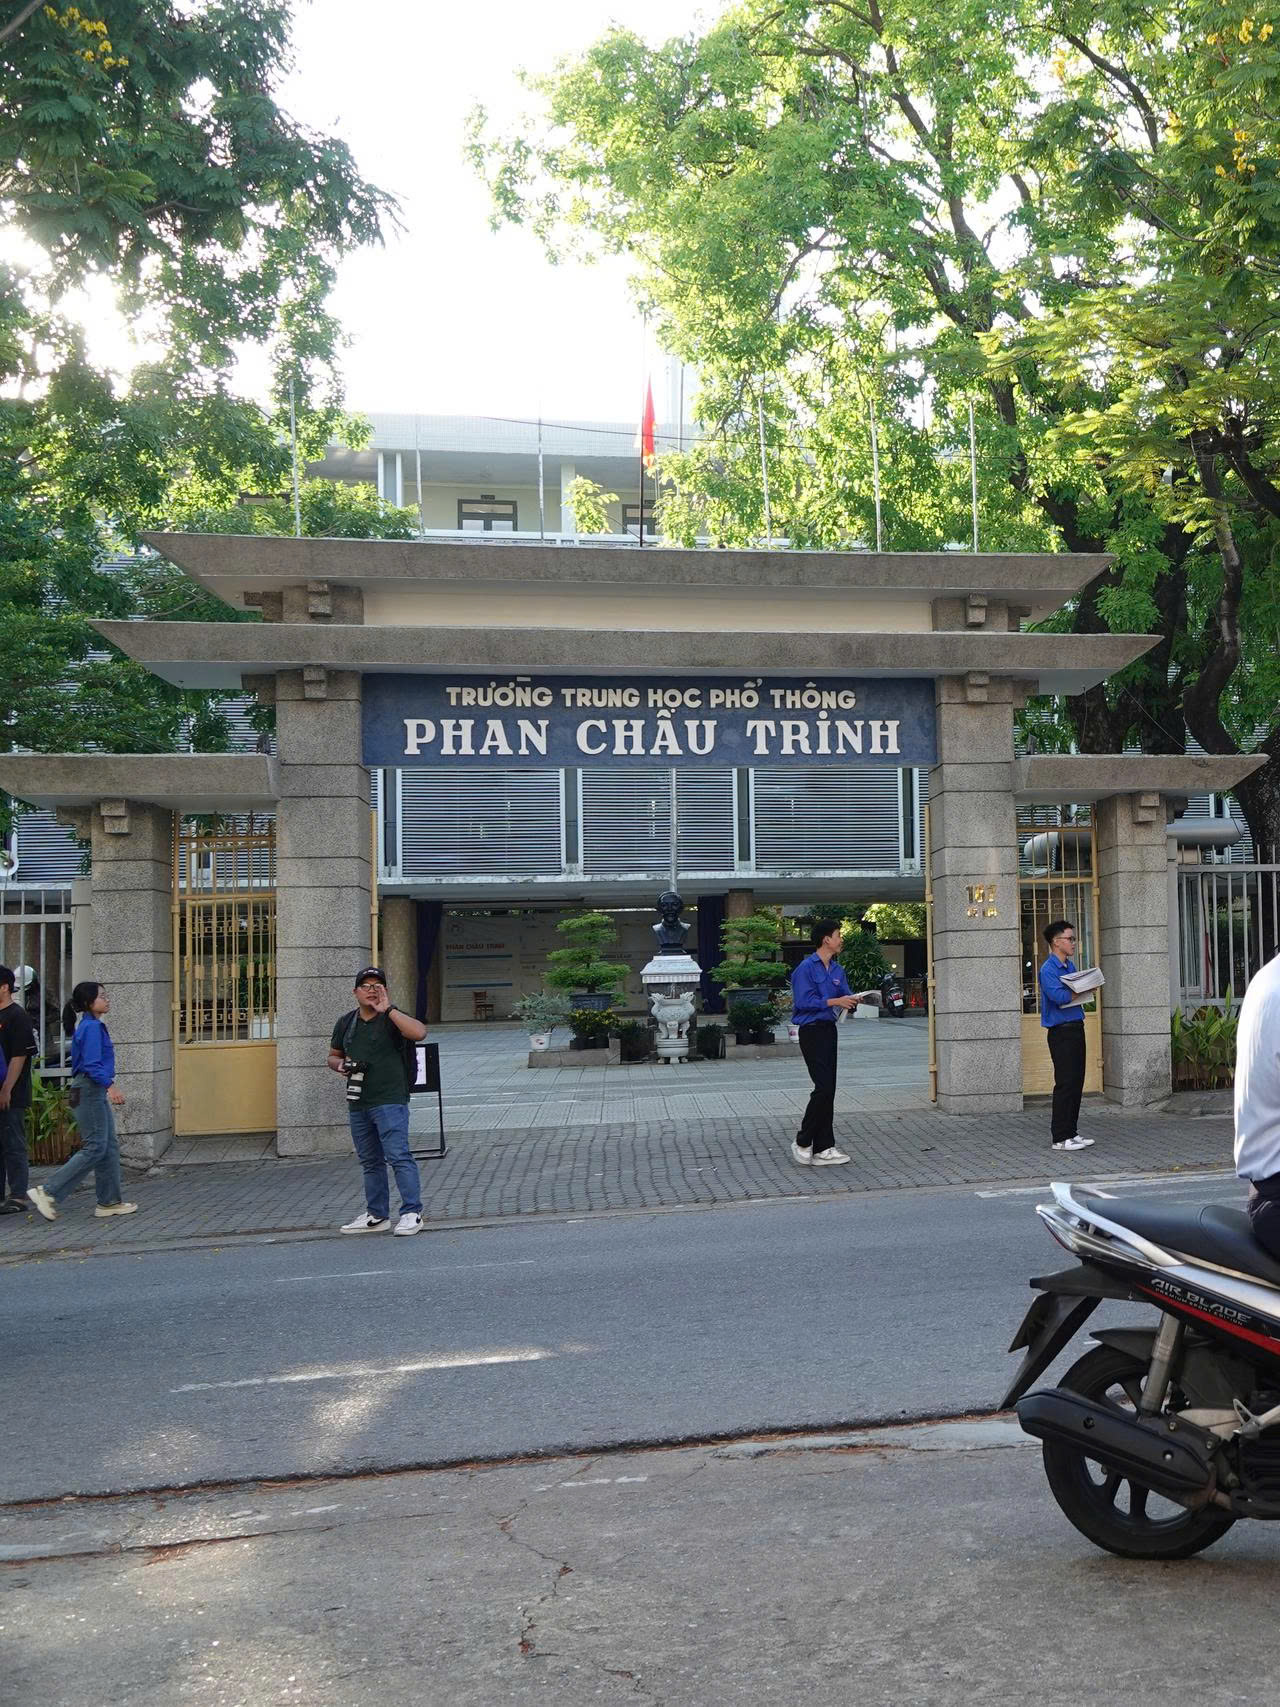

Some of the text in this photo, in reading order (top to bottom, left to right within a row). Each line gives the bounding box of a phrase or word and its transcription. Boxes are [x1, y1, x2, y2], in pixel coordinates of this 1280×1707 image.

[561, 687, 640, 708] TRUNG
[647, 687, 702, 713] HỌC
[710, 678, 763, 708] PHỔ
[770, 681, 857, 710] THÔNG
[403, 709, 901, 755] PHAN CHÂU TRINH
[1151, 1278, 1253, 1323] AIR BLADE
